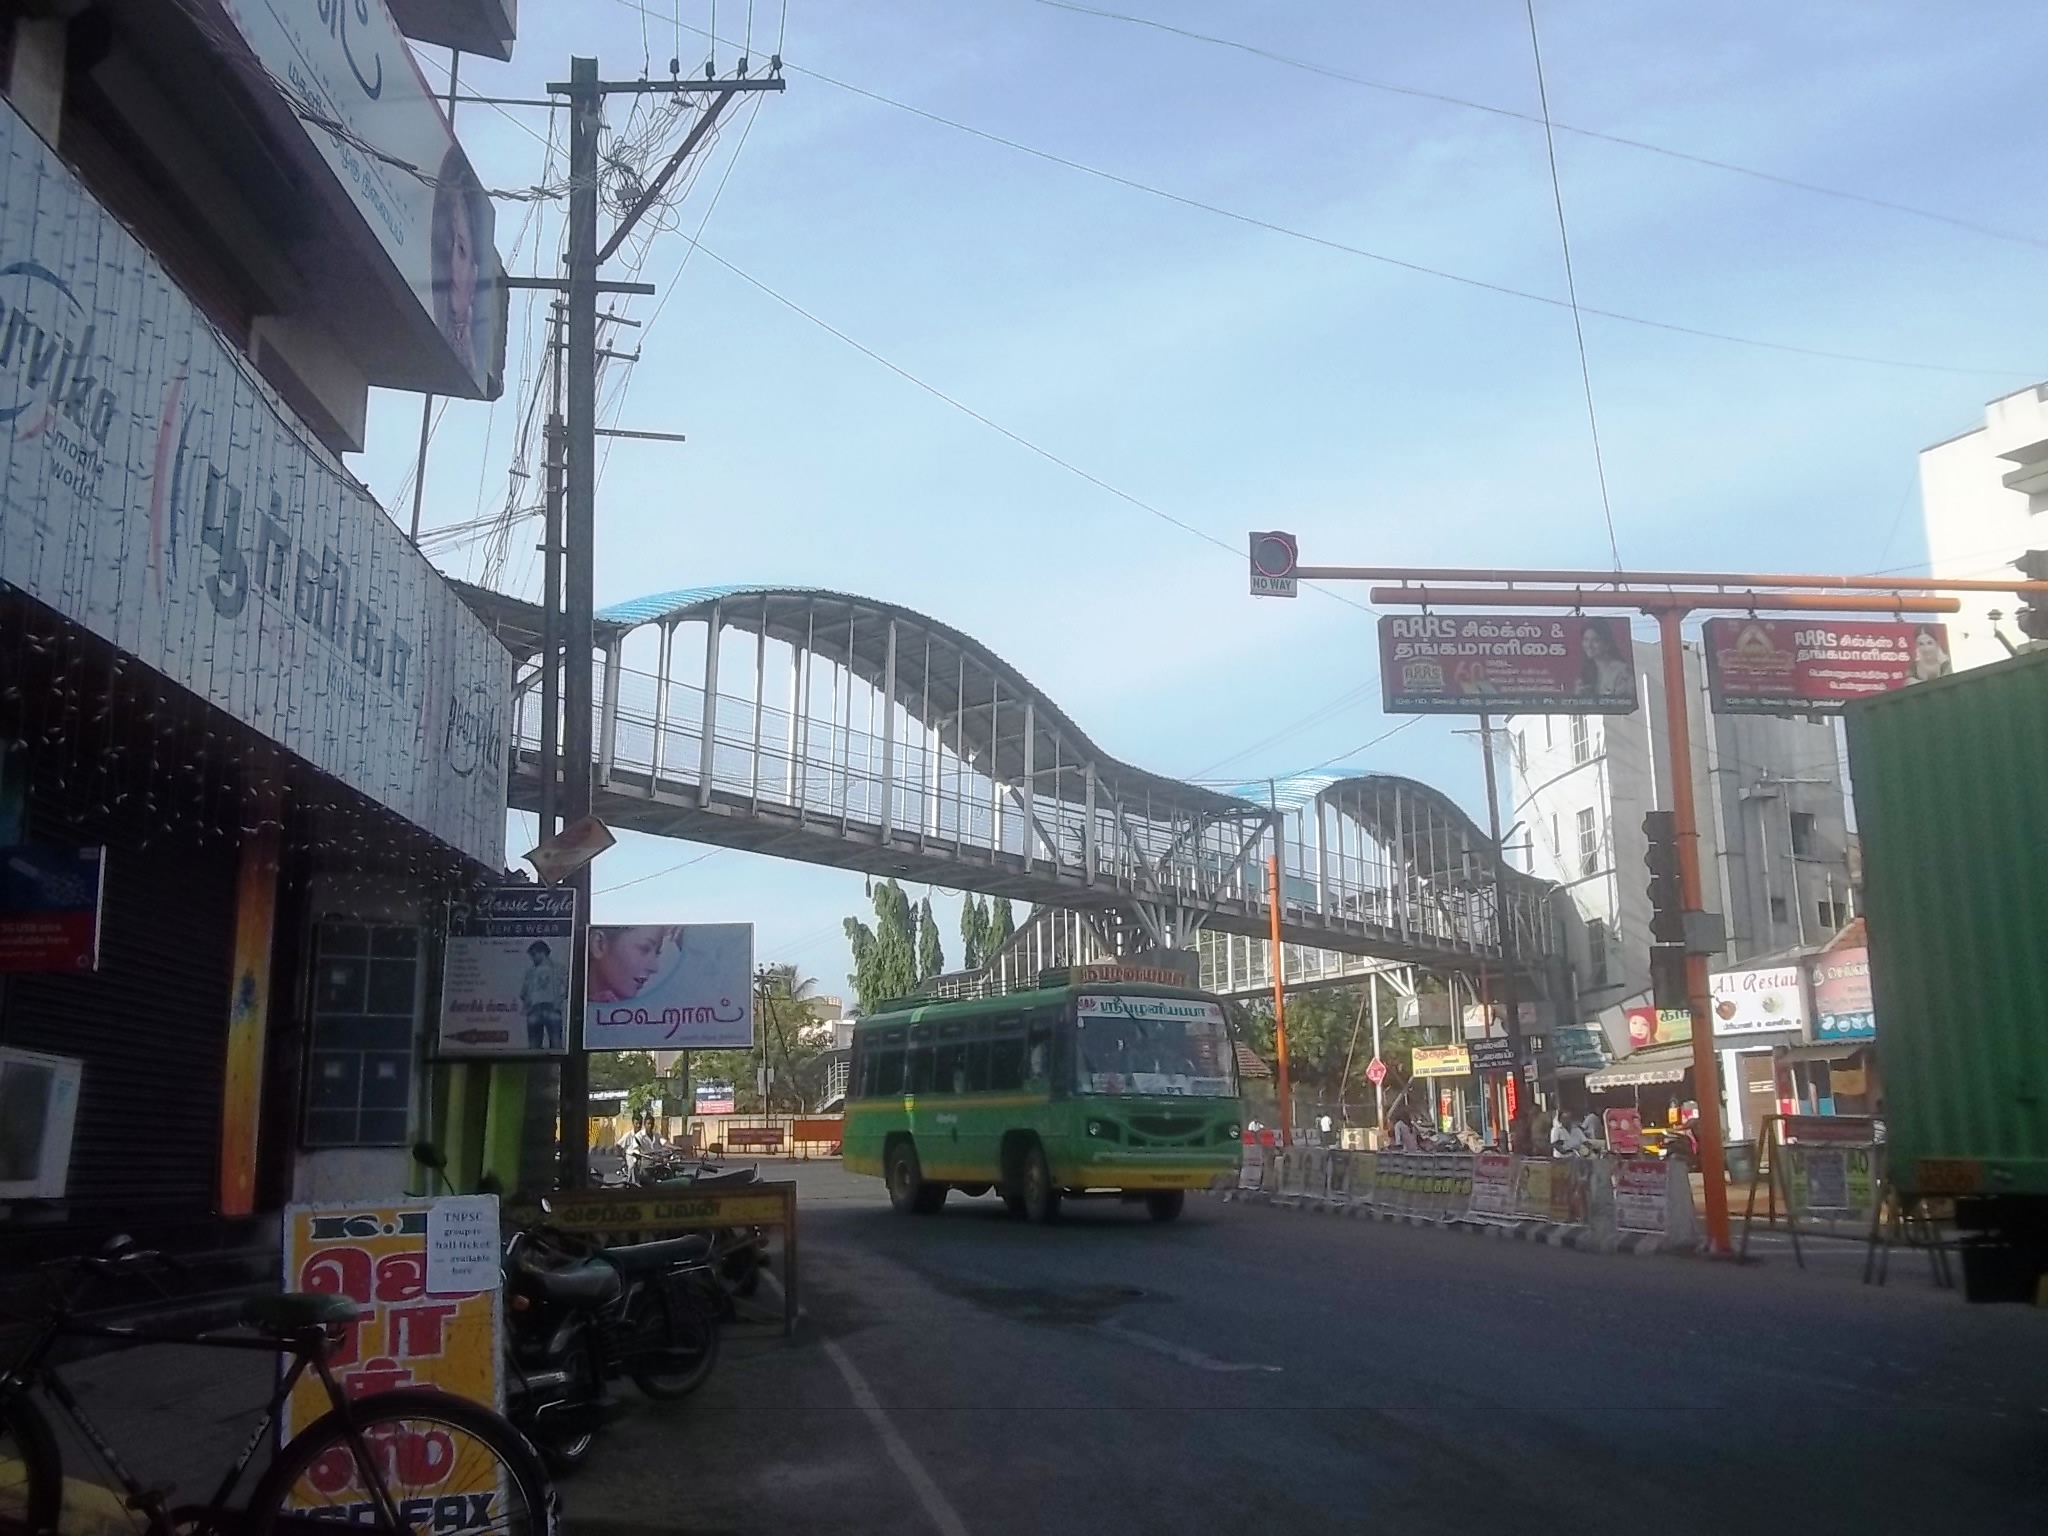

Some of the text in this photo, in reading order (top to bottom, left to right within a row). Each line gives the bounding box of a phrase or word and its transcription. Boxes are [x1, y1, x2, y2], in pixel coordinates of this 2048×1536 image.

[1253, 577, 1291, 591] NO WAY
[1462, 620, 1542, 638] சில்க்ஸ்
[1551, 622, 1564, 638] &
[1840, 633, 1893, 648] சில்க்ஸ்
[1897, 636, 1908, 648] &
[1394, 638, 1567, 661] தங்கமாளிகை
[1796, 646, 1911, 662] தங்கமாளிகை
[532, 893, 574, 916] Style
[526, 923, 560, 934] WEAR
[443, 1212, 483, 1222] TNPSC
[435, 1240, 491, 1249] hall ticket
[400, 1494, 496, 1533] FAX
